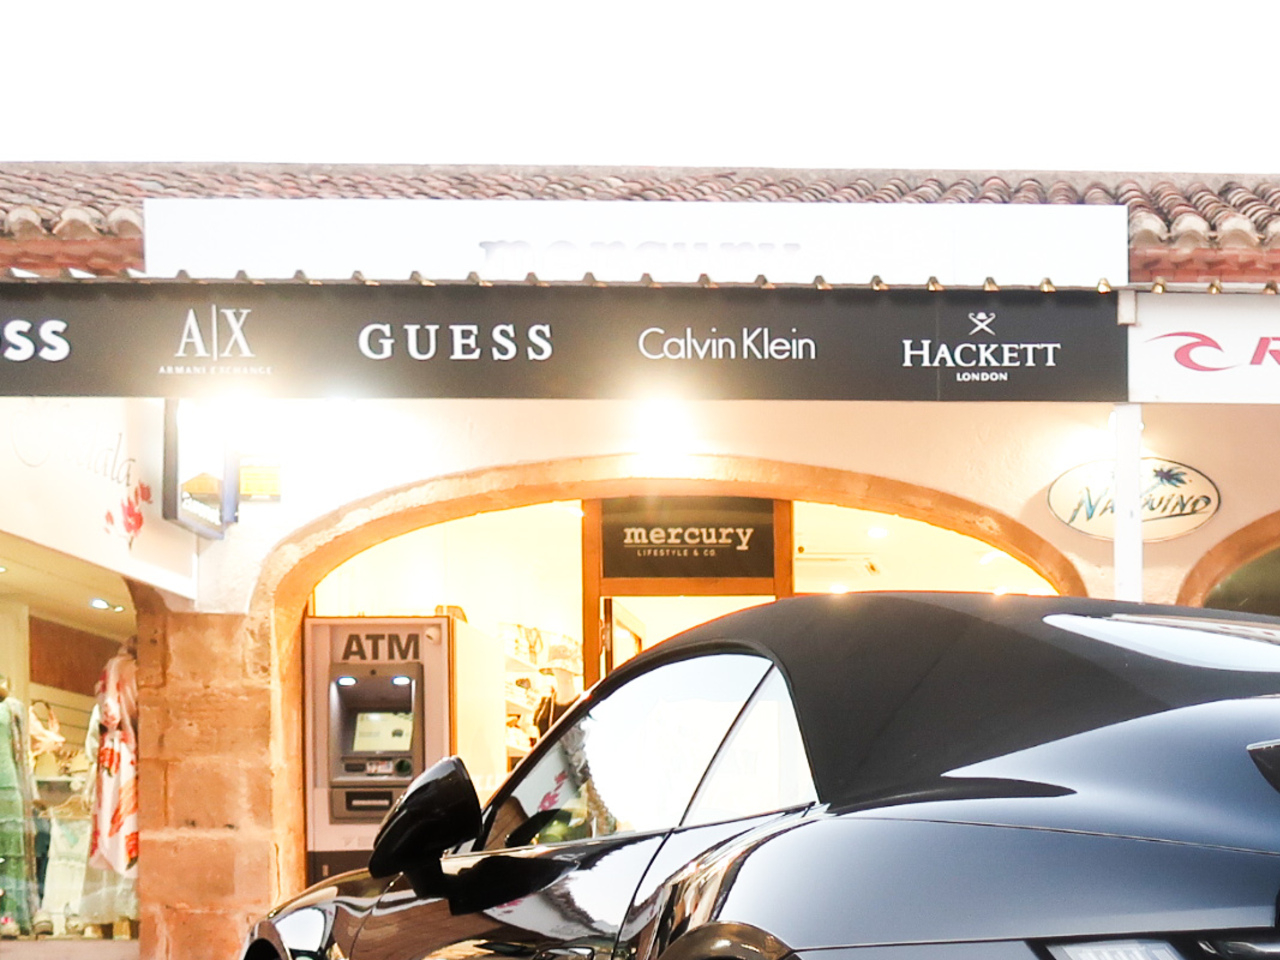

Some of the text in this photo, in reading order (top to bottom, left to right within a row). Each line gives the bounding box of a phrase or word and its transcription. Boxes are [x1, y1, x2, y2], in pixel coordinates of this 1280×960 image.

[358, 322, 554, 361] GUESS
[638, 326, 816, 361] Calvin Klein
[902, 339, 1061, 368] HACKETT
[158, 365, 273, 375] ARMANI EXCHANGE
[956, 372, 1008, 382] LONDON
[623, 526, 754, 551] mercury
[637, 549, 689, 557] LIFESTYLE
[693, 549, 700, 557] &
[342, 633, 420, 661] ATM
